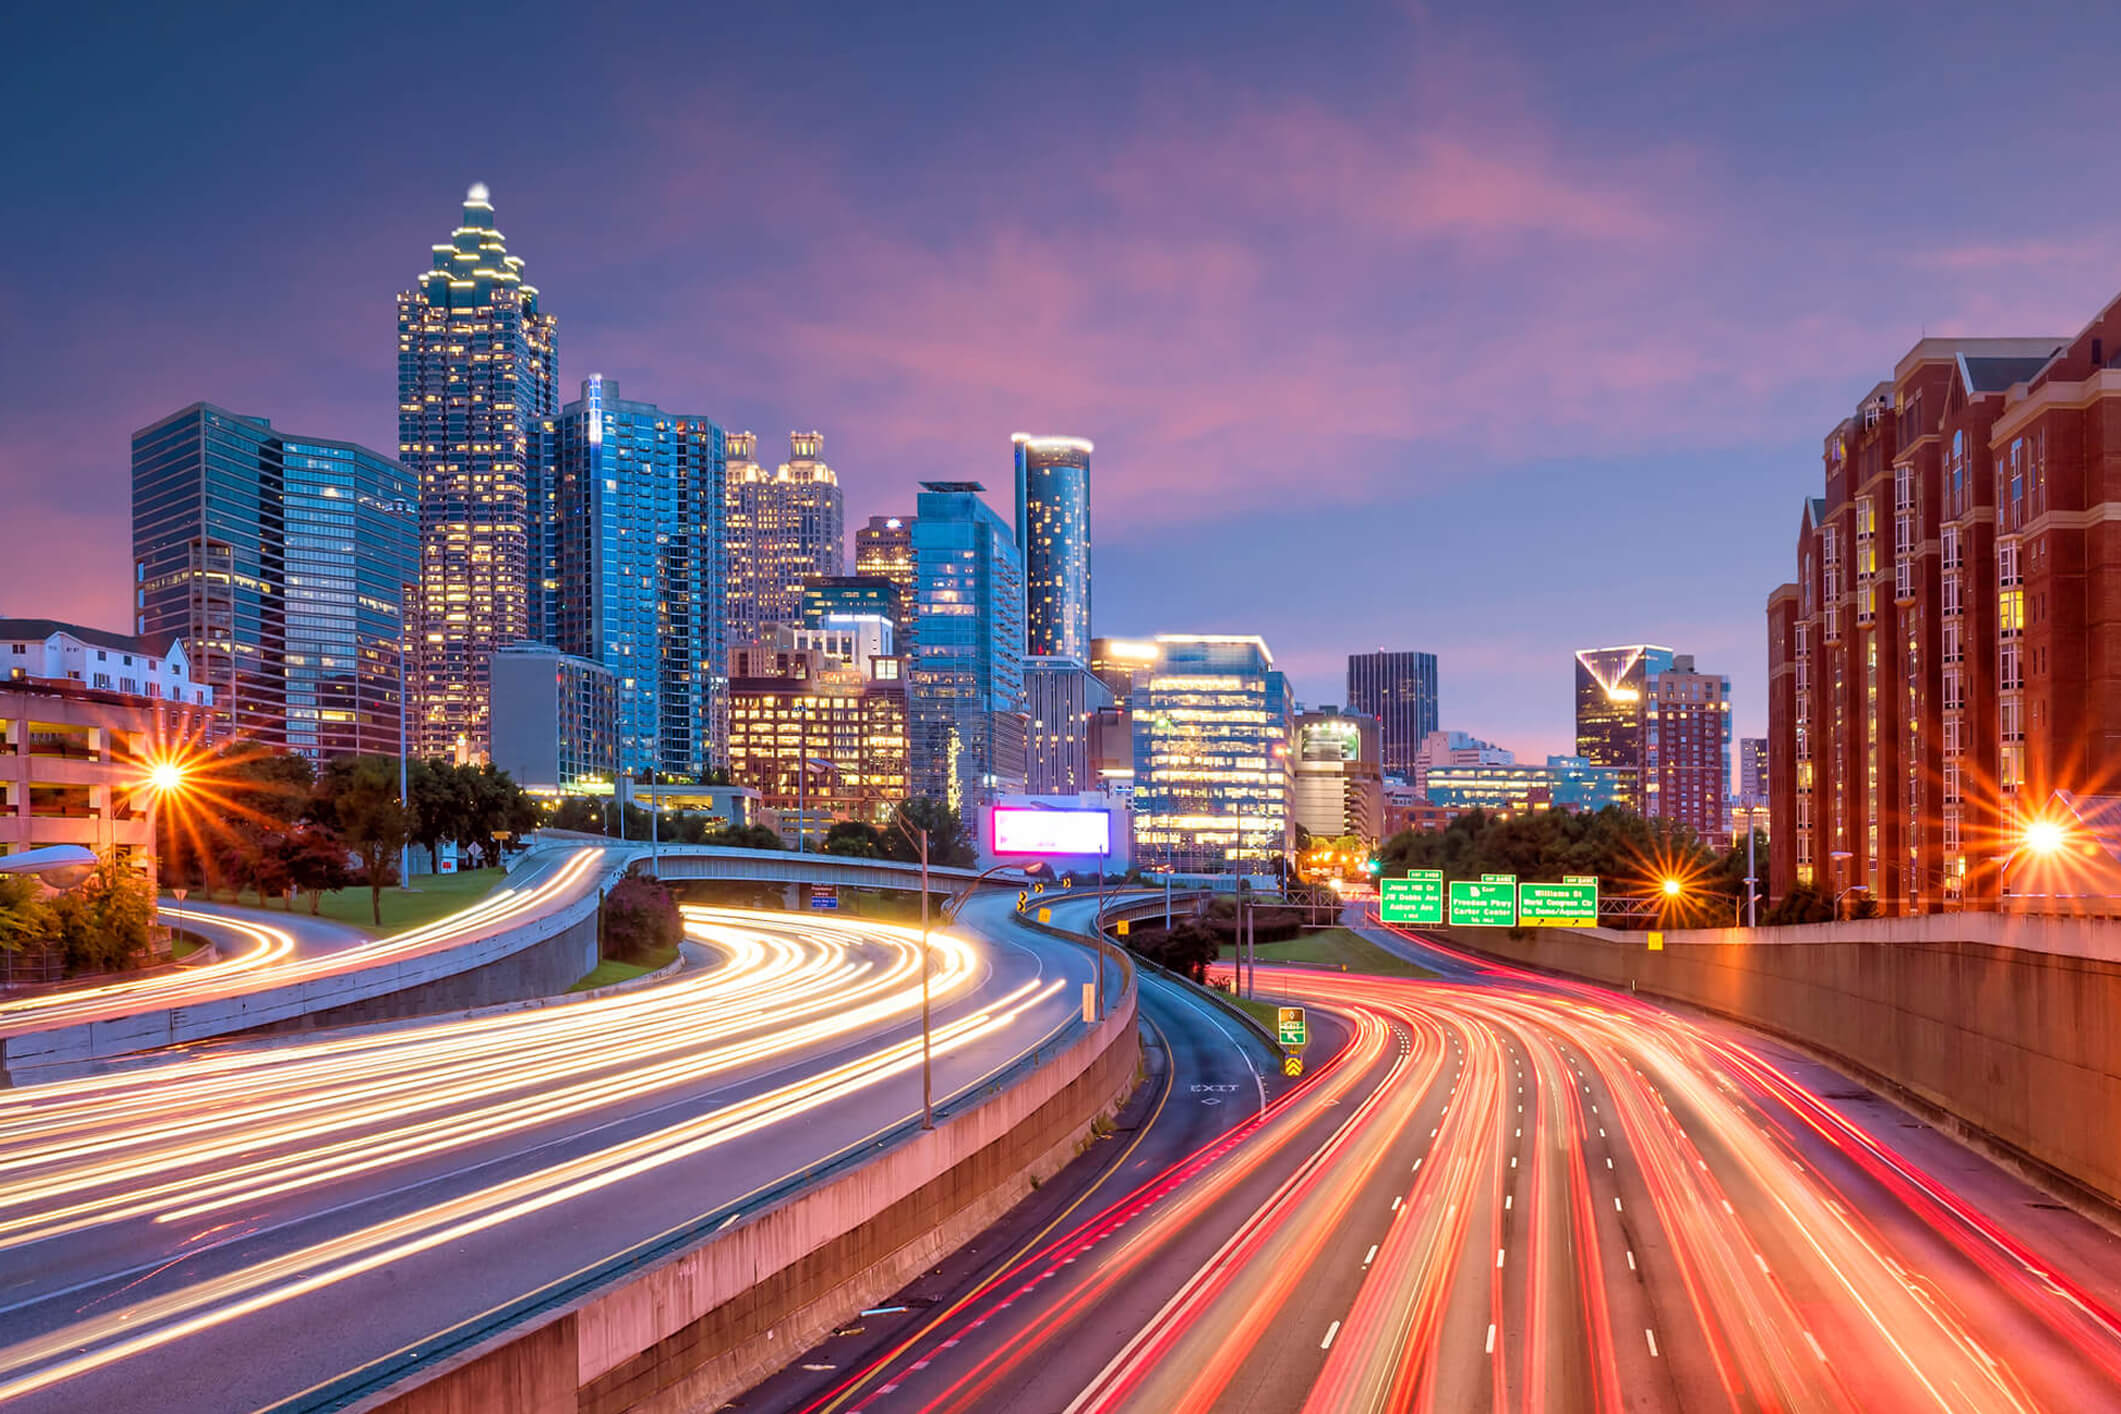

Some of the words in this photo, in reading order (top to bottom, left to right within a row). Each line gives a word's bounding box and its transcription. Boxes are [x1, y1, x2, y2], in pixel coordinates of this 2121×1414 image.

[1573, 890, 1582, 898] St
[1453, 898, 1487, 906] Freedom
[1490, 899, 1512, 908] Pkwy
[1454, 907, 1480, 915] Carter
[1483, 908, 1511, 916] Center
[1191, 1084, 1240, 1092] EXIT
